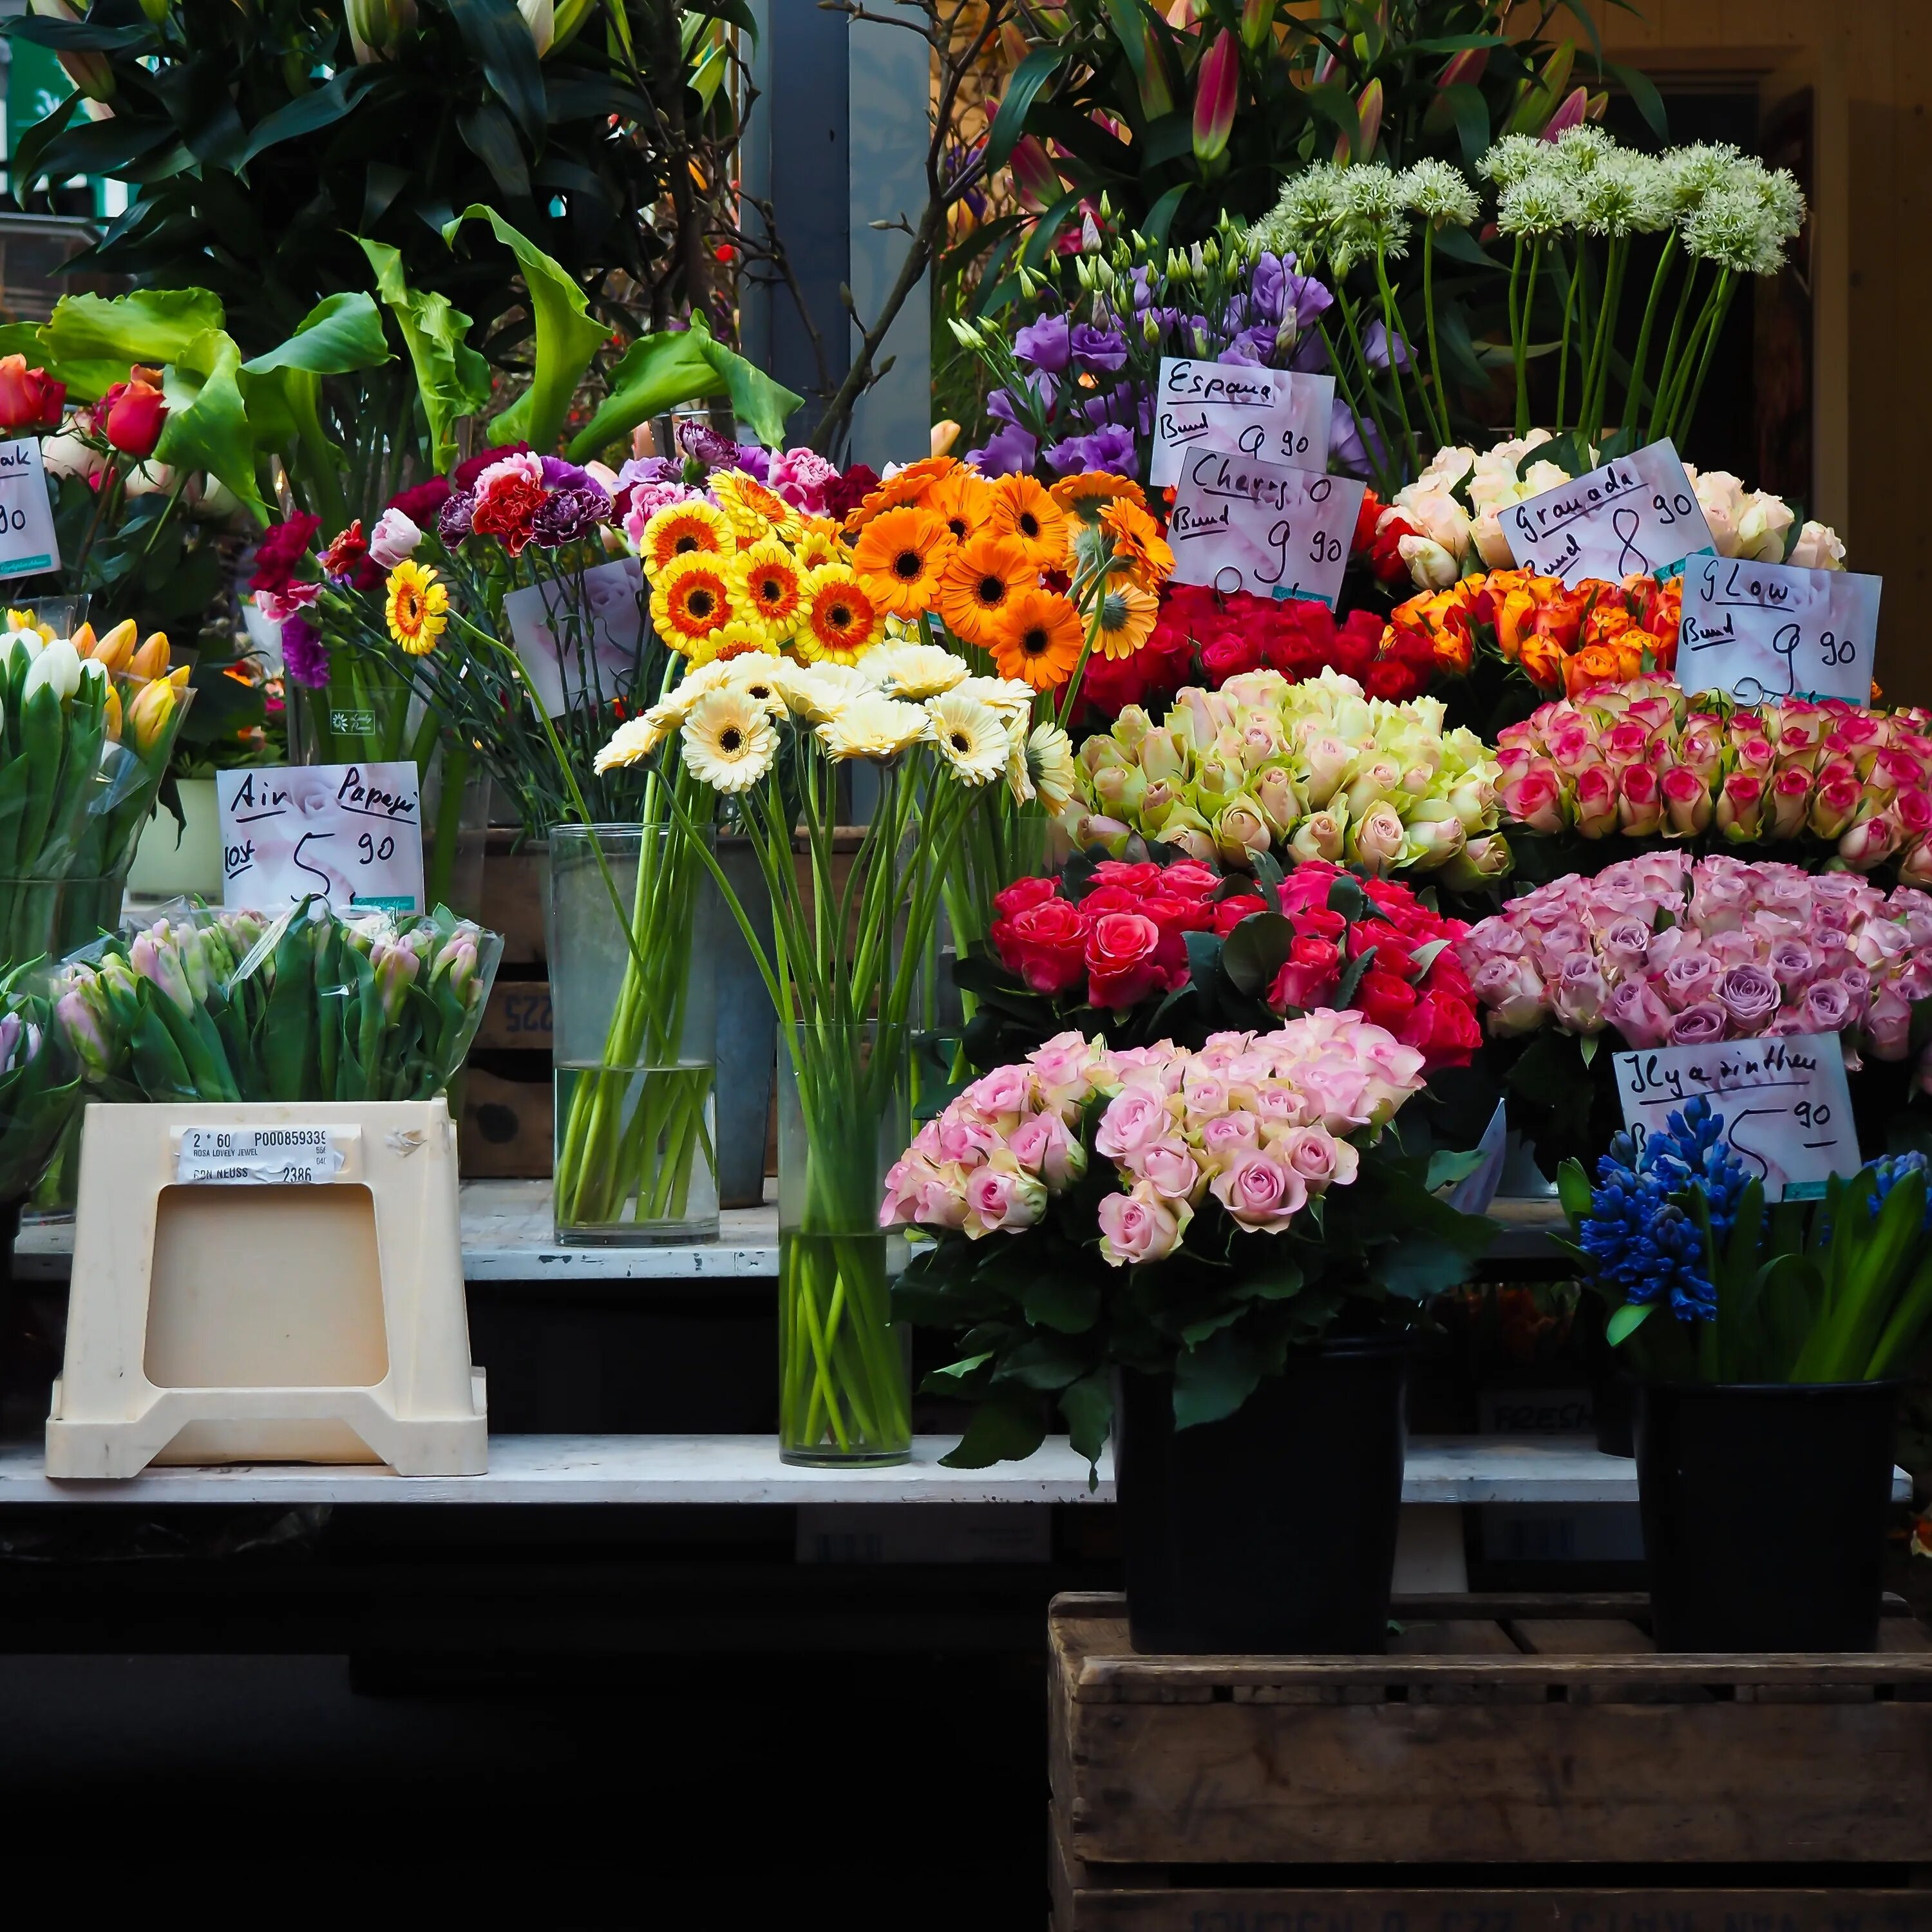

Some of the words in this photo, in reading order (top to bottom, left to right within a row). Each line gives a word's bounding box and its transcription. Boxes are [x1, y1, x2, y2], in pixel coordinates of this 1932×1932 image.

[1160, 412, 1209, 439] Bund
[1238, 425, 1265, 460] 9
[1281, 430, 1309, 457] 90
[1173, 504, 1229, 531] Bund
[1653, 493, 1692, 524] 90
[1253, 520, 1291, 584] 9
[1309, 531, 1342, 562] 90
[1612, 508, 1649, 576] 8
[1682, 612, 1734, 645] Bund
[1761, 623, 1800, 697] 9
[1821, 631, 1856, 666] 90
[231, 773, 287, 812] Air
[290, 832, 336, 903] 5
[357, 833, 395, 865] 90
[193, 1149, 211, 1157] ROSA
[213, 1149, 235, 1157] LOVELY
[194, 1133, 200, 1148] 2
[217, 1133, 231, 1148] 60
[1728, 1108, 1788, 1183] 5
[1794, 1101, 1831, 1128] 90
[216, 1167, 249, 1179] NEUSS
